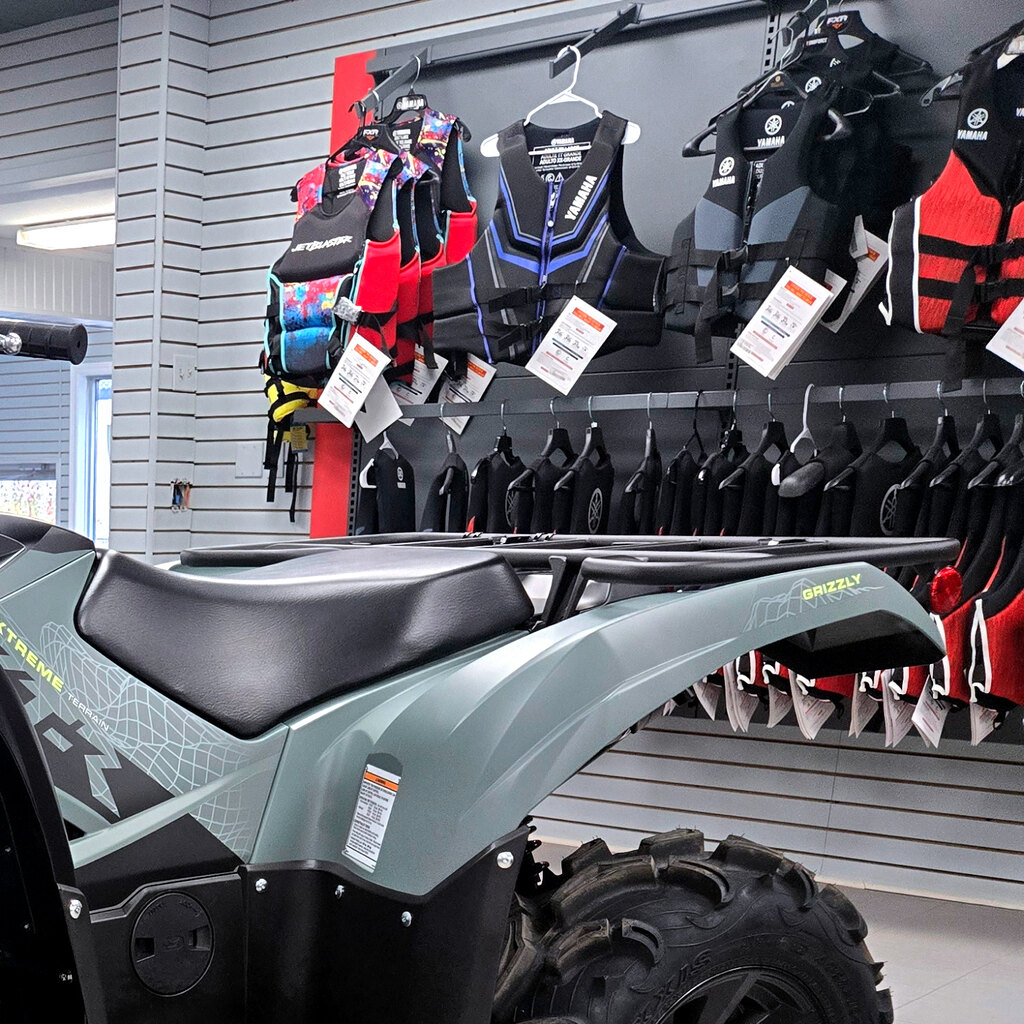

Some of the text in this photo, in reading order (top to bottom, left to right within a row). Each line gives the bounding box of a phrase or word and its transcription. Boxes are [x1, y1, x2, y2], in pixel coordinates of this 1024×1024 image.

[757, 135, 785, 147] YAMAHA
[957, 129, 988, 141] YAMAHA
[712, 176, 735, 188] YAMAHA
[564, 175, 598, 220] YAMAHA
[291, 235, 353, 252] JETBLASTER
[802, 573, 861, 600] GRIZZLY
[67, 692, 110, 732] TERRAIN
